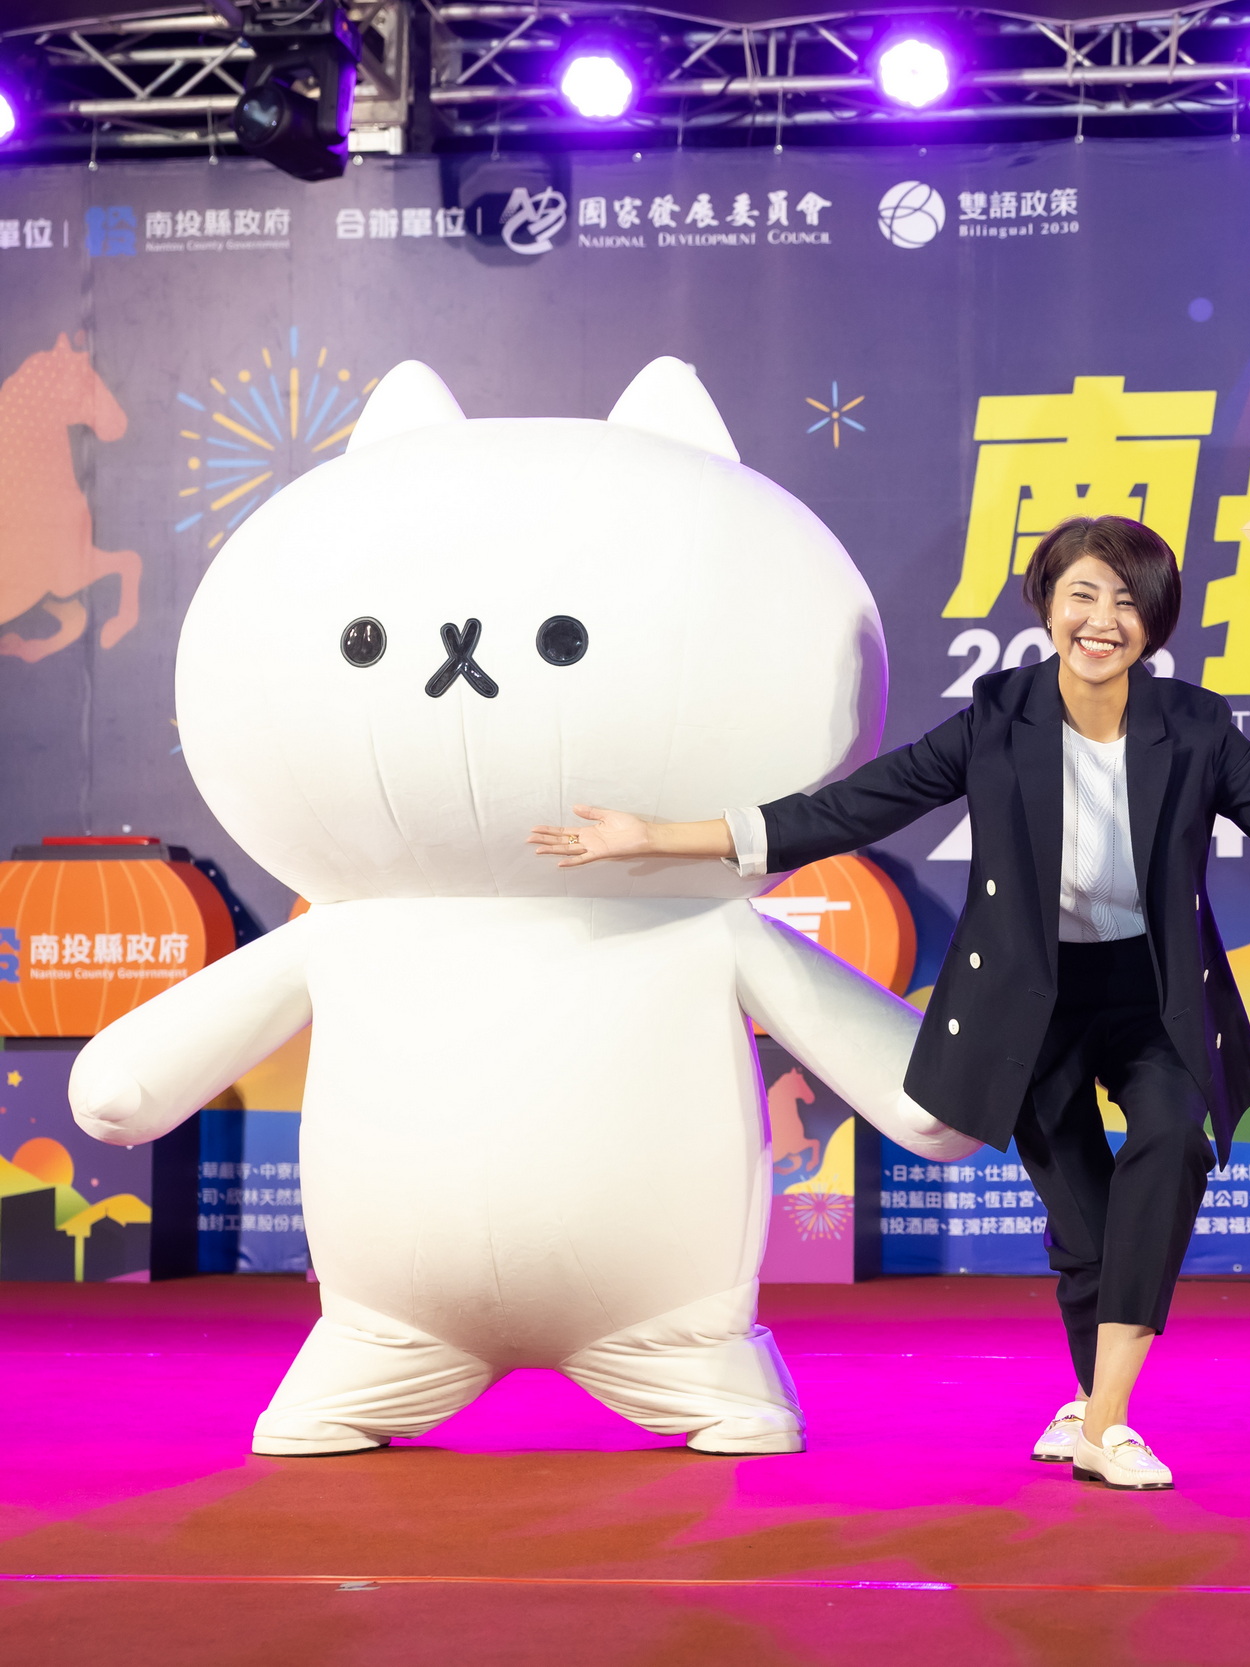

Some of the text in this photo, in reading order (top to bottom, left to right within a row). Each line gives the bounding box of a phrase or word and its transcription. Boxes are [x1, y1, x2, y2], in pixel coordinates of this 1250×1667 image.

[578, 191, 832, 229] 國家發展委員會
[957, 188, 1079, 222] 雙語政策
[145, 207, 291, 240] 南投縣政府
[336, 207, 466, 240] 合辦單位
[578, 229, 832, 248] NATIONAL DEVELOPMENT COUNCIL
[959, 220, 1080, 238] Bilingual 2030
[145, 241, 184, 253] Nantou
[186, 239, 224, 252] County
[30, 933, 189, 965] 南投縣政府
[30, 967, 188, 981] Nantou County Government
